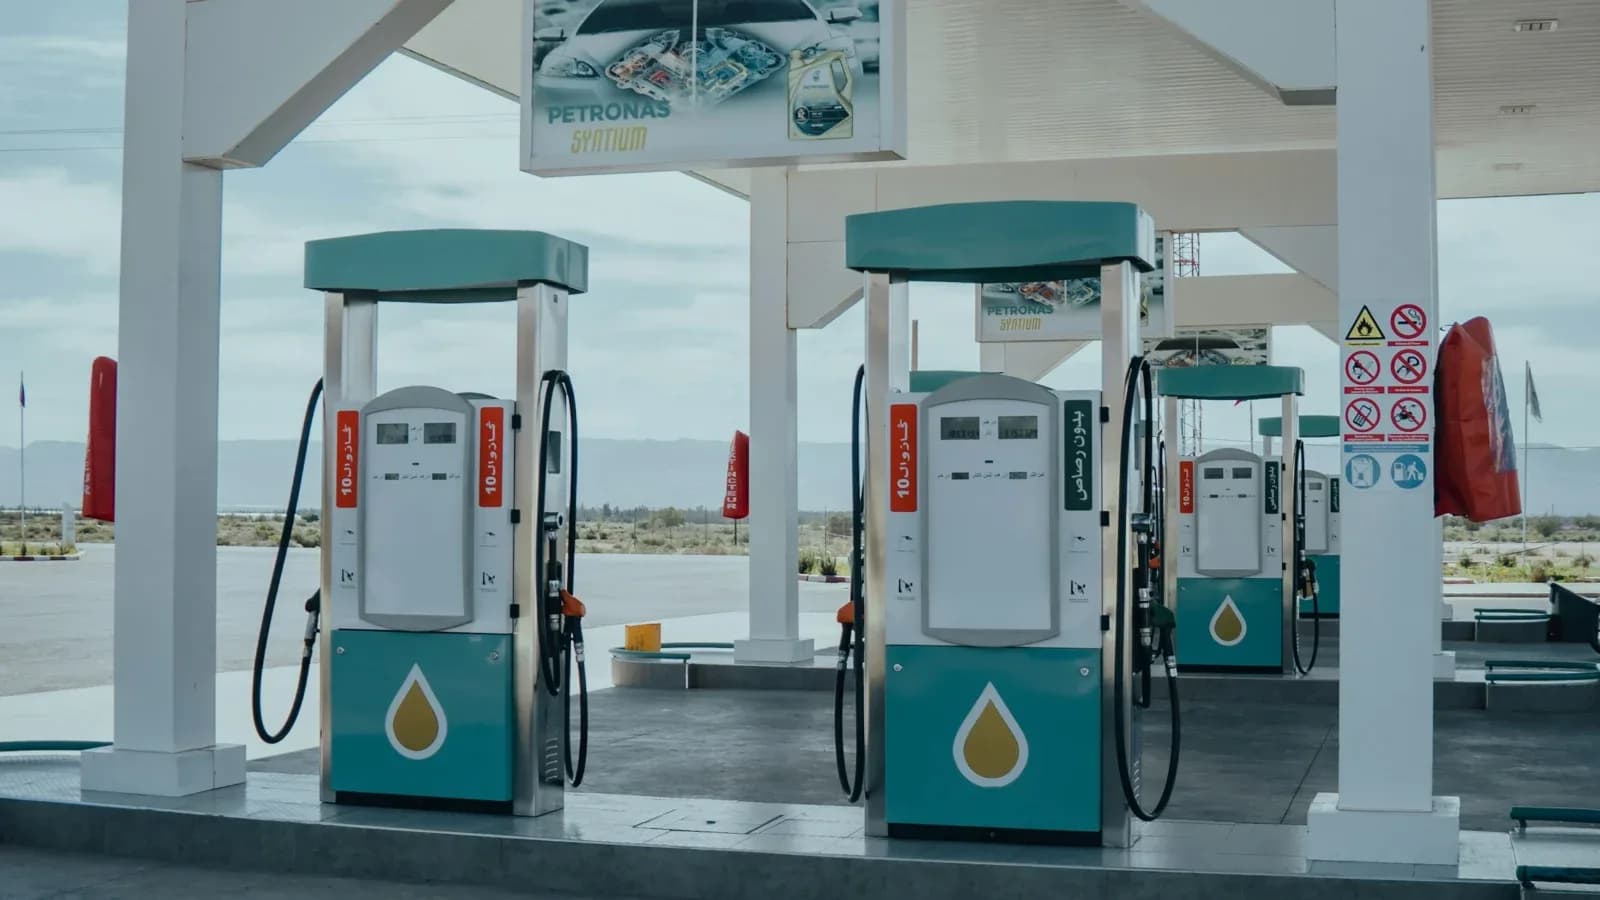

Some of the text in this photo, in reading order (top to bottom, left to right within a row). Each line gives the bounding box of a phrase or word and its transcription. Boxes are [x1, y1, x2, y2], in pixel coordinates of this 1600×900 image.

[547, 99, 671, 124] PETRONAS
[570, 125, 648, 154] SYNTIUM
[987, 305, 1054, 316] PETRONAS
[1071, 410, 1088, 501] بدون رصاص
